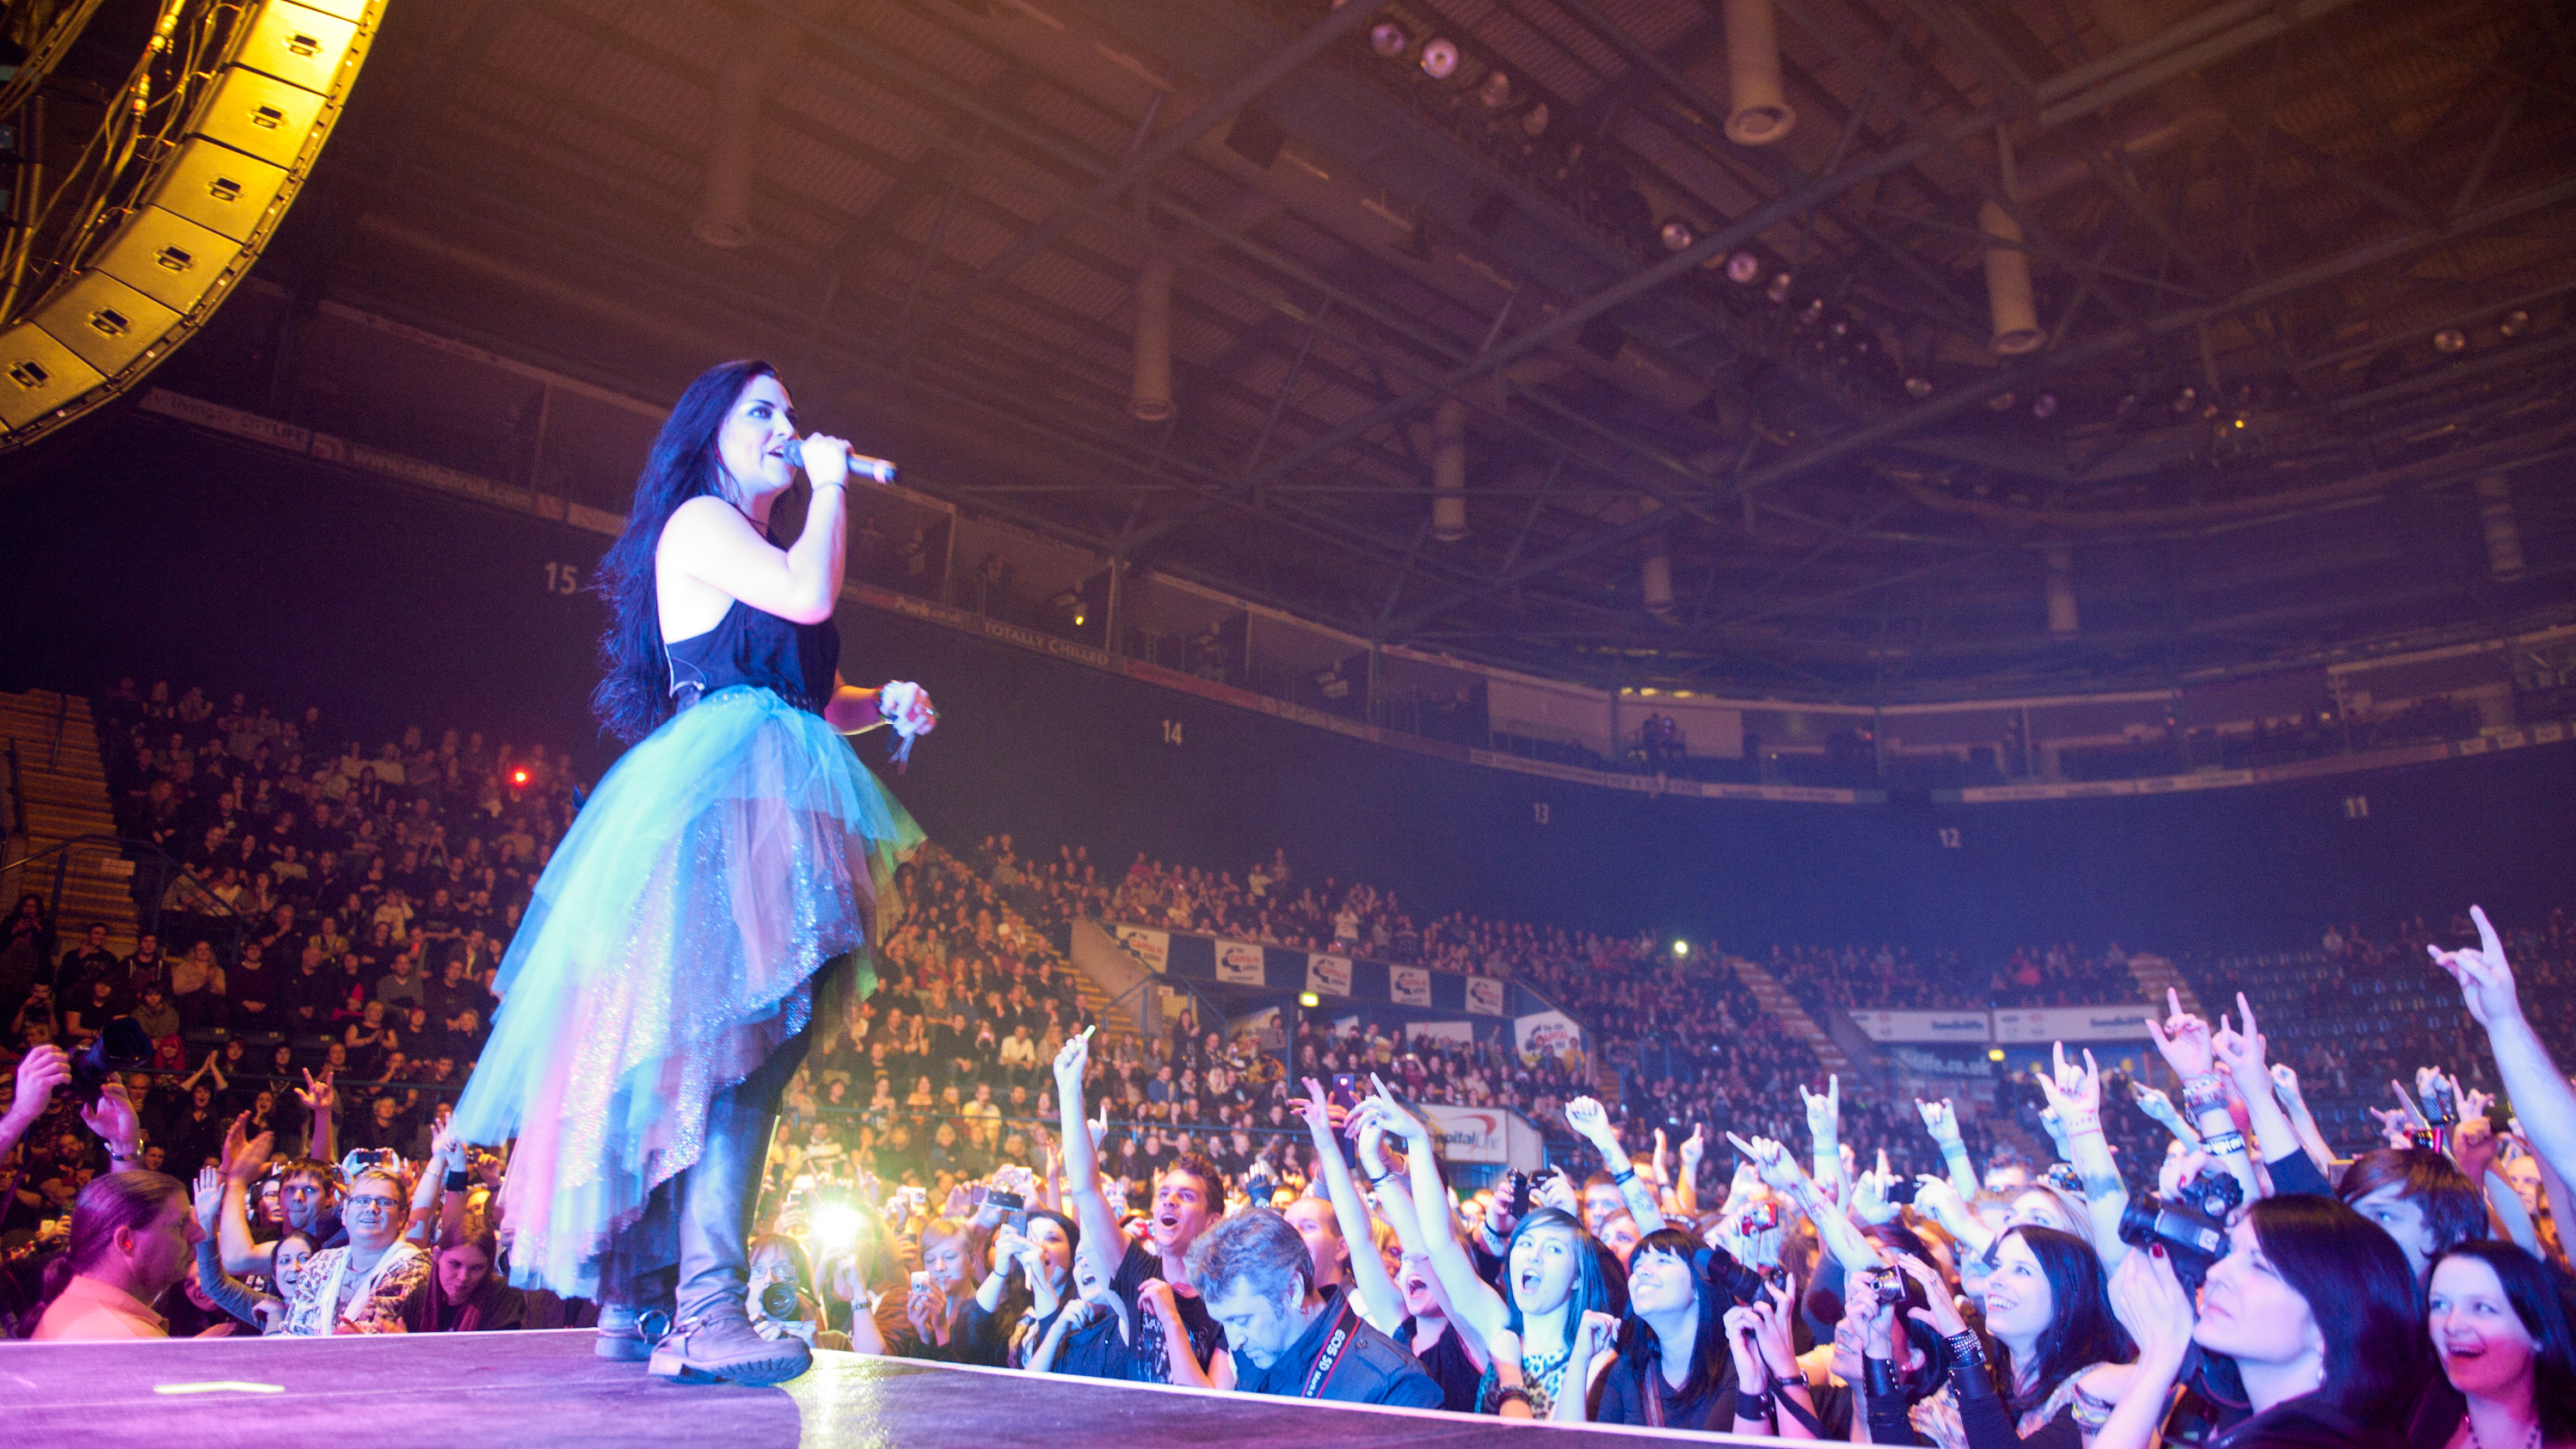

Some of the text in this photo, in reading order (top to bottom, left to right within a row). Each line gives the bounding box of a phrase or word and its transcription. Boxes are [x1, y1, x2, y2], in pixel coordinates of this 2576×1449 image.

[544, 562, 578, 595] 15
[983, 621, 1109, 666] TOTALLY CHILLED
[1161, 719, 1183, 746] 14
[1534, 802, 1549, 824] 13
[2345, 795, 2368, 818] 11
[1939, 826, 1962, 849] 12
[1326, 1329, 1346, 1356] EOS
[1319, 1354, 1333, 1372] 5D
